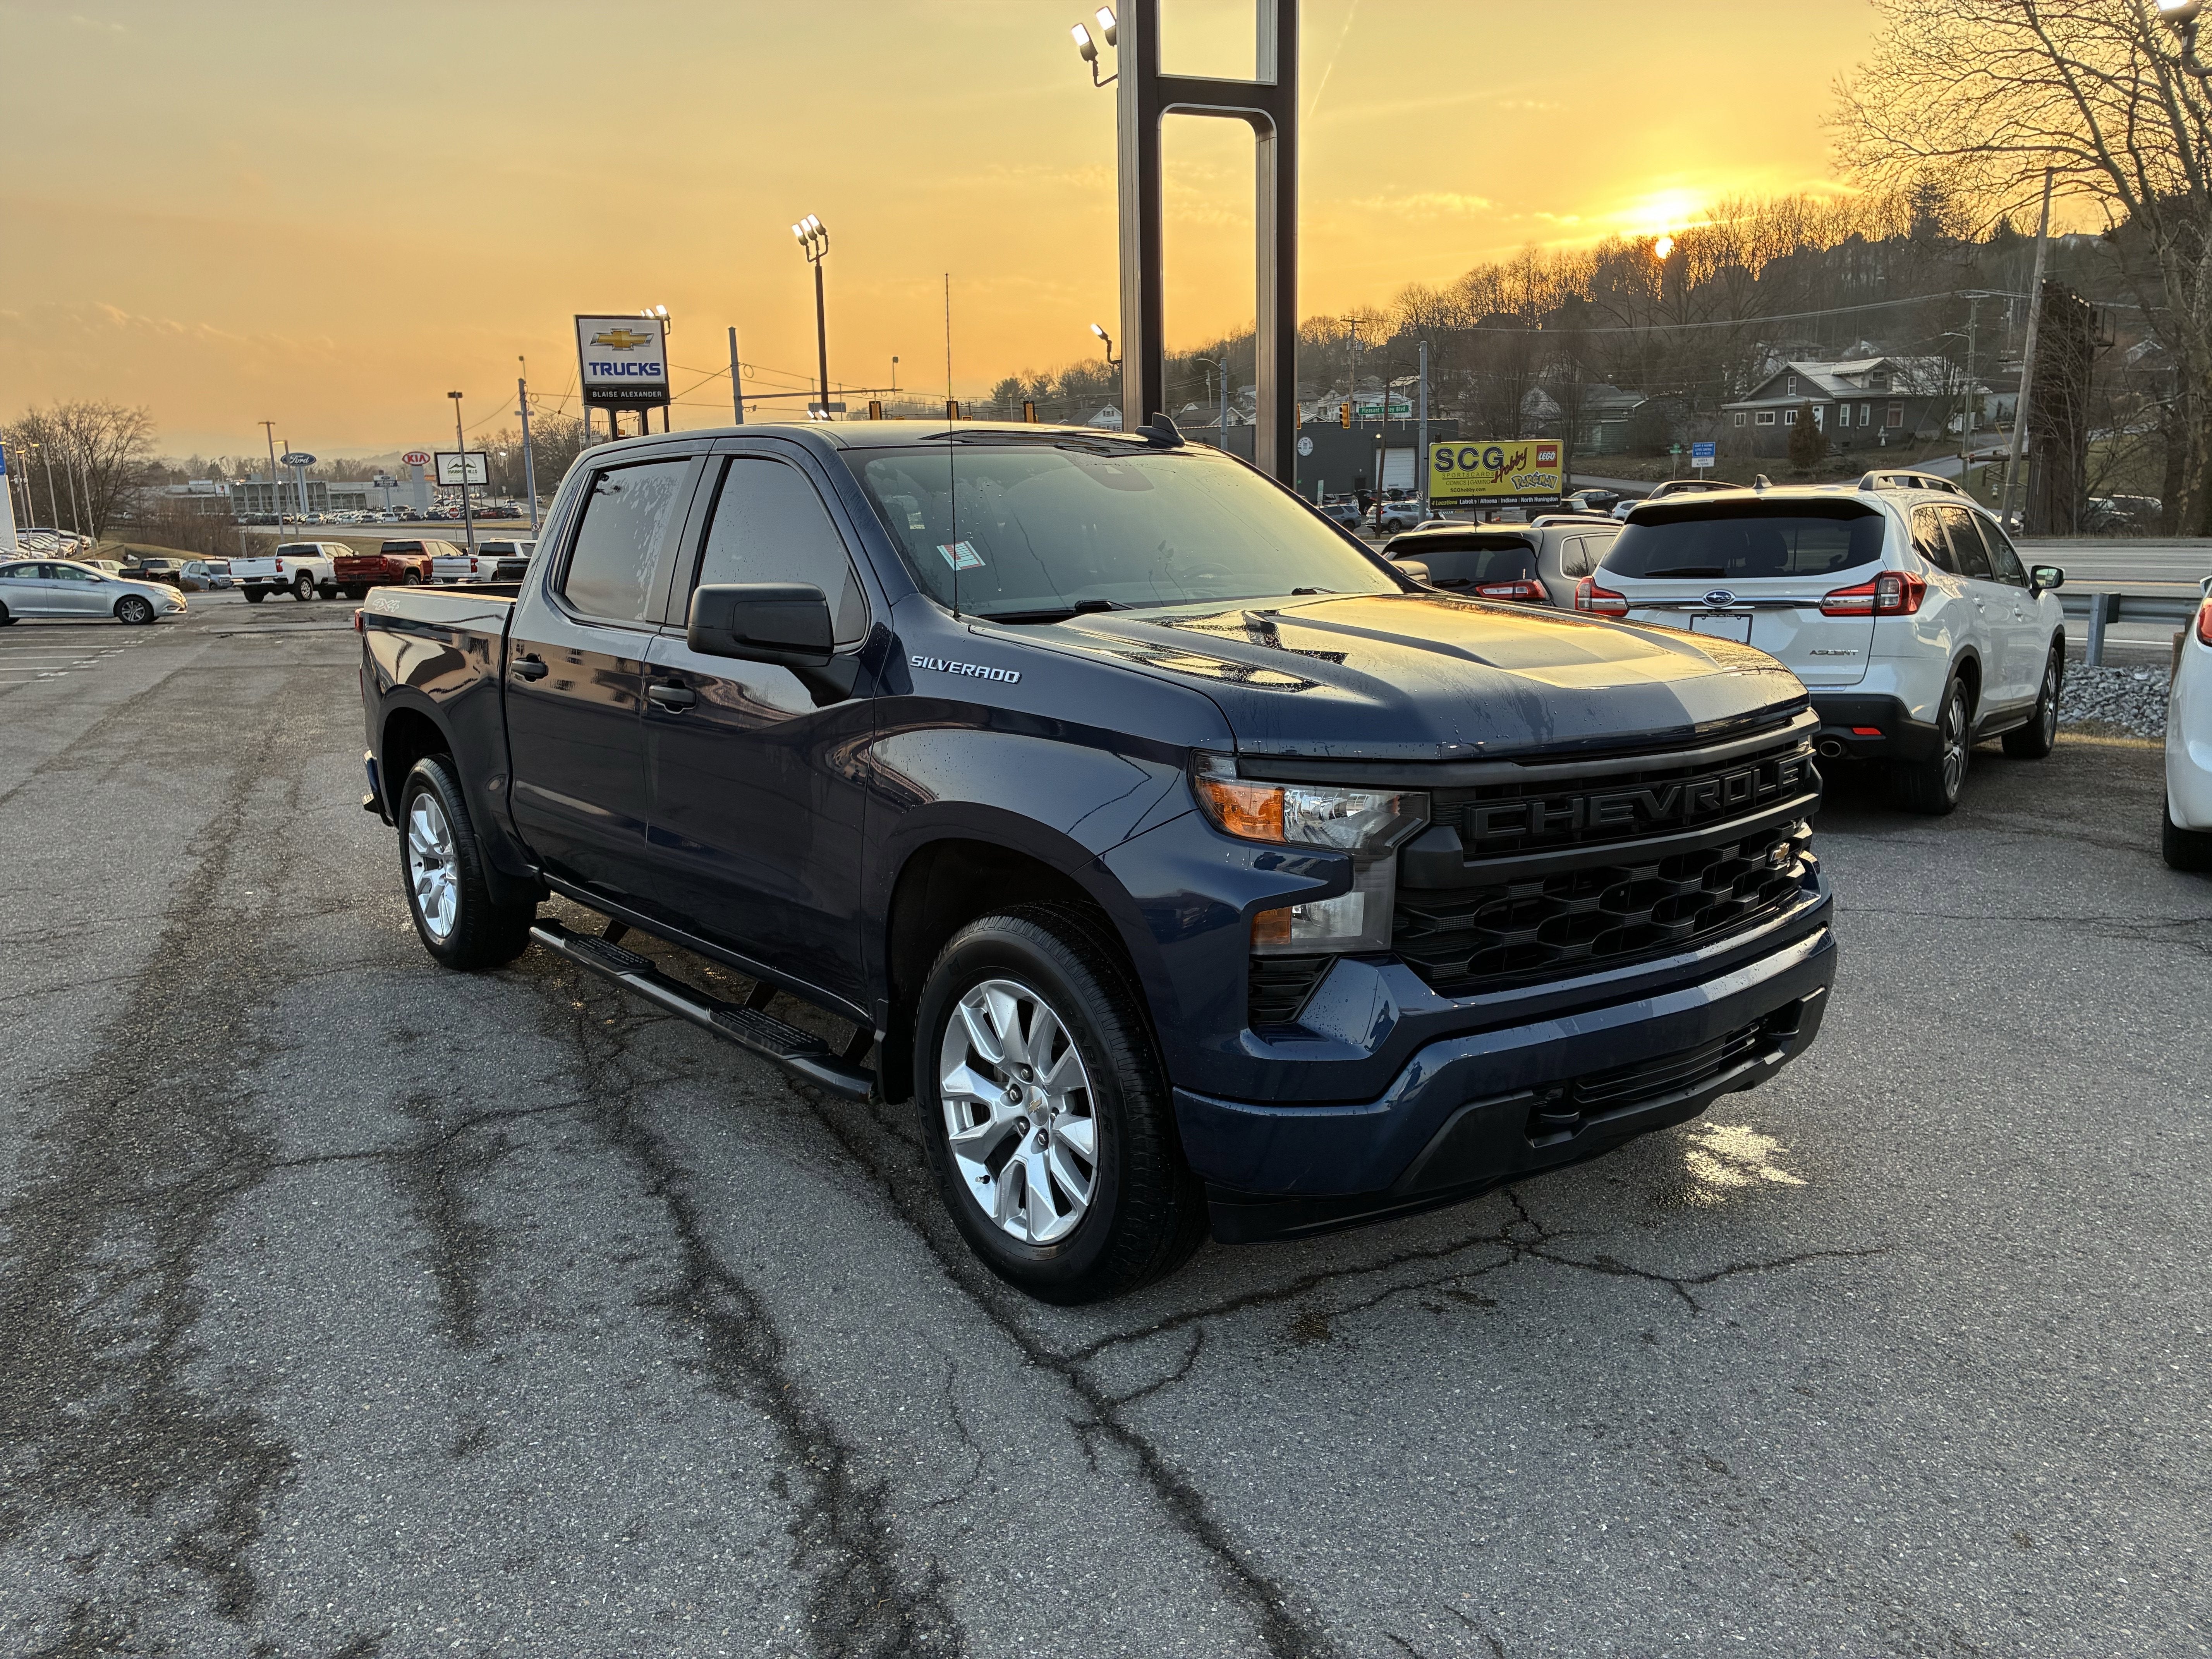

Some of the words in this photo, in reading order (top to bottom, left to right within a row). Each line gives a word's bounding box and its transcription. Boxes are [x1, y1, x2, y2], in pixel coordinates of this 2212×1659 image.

[588, 362, 661, 376] TRUCKS
[289, 454, 310, 464] Ford
[407, 454, 426, 463] KIA
[1434, 446, 1504, 472] SCG
[1537, 451, 1556, 461] LEGO
[1491, 447, 1528, 484] Hobby
[910, 655, 1022, 685] SILVERADO
